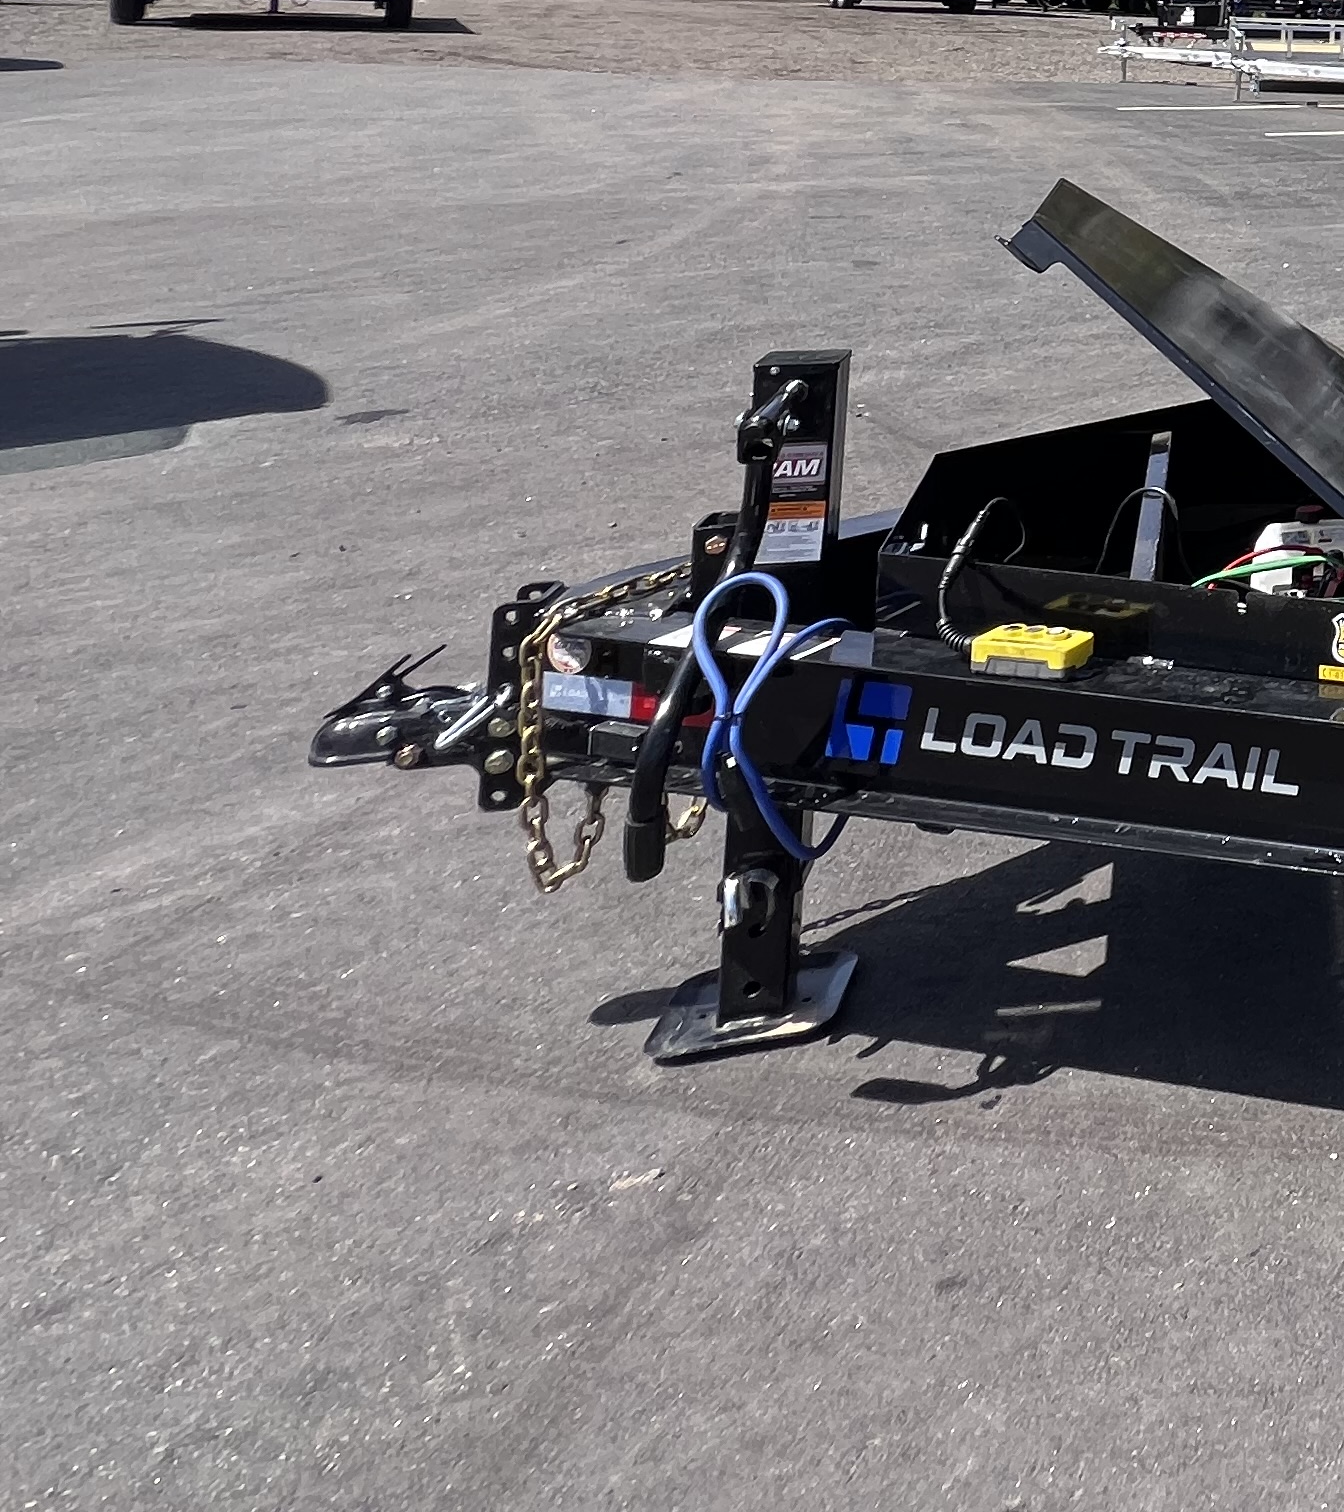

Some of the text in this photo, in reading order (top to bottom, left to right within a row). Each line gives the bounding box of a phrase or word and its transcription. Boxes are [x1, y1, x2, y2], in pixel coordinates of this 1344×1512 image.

[773, 458, 820, 478] AM
[920, 707, 1299, 797] LOAD TRAIL
